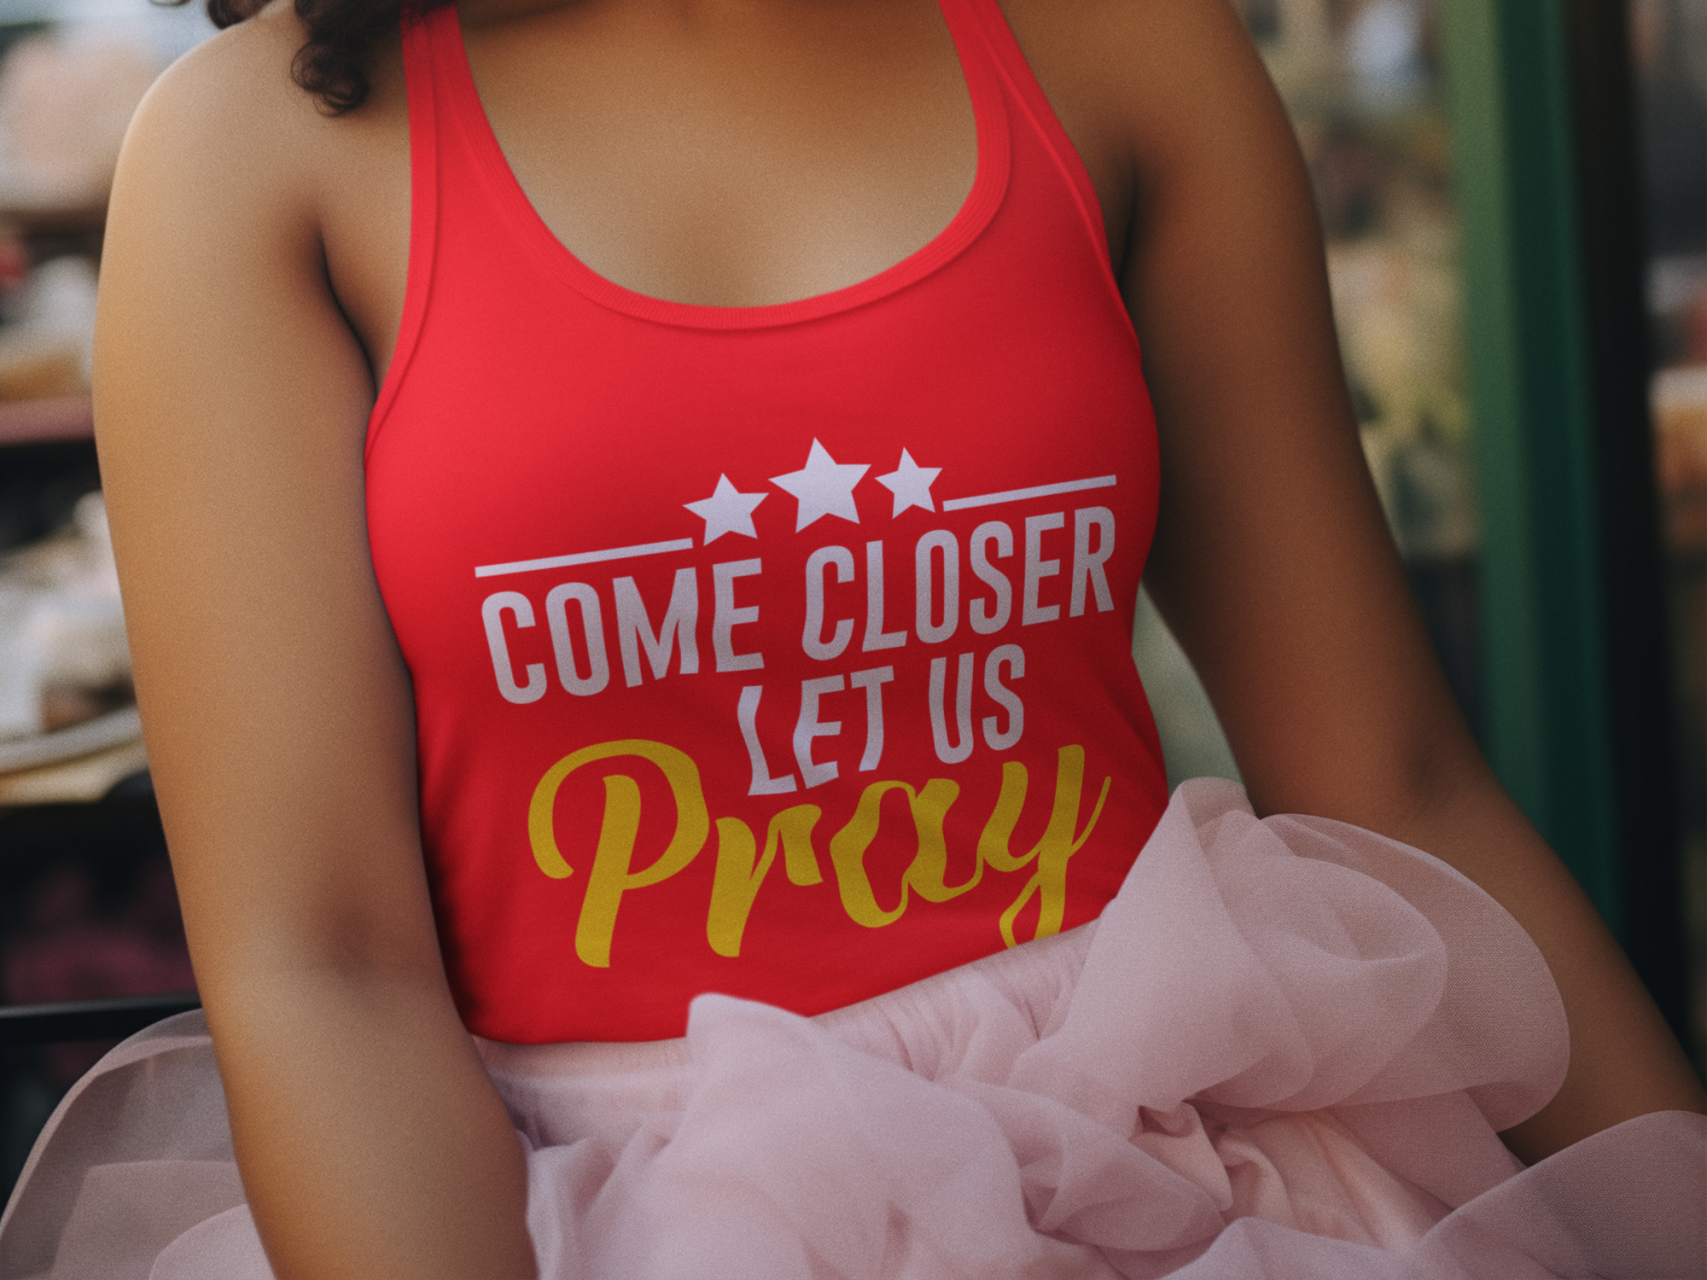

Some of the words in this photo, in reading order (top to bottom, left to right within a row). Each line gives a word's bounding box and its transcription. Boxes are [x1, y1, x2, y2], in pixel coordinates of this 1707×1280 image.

[481, 557, 765, 705] COME
[801, 505, 1116, 661] CLOSER
[736, 665, 895, 796] LET
[928, 644, 1025, 764] US
[527, 738, 1111, 968] Pray
